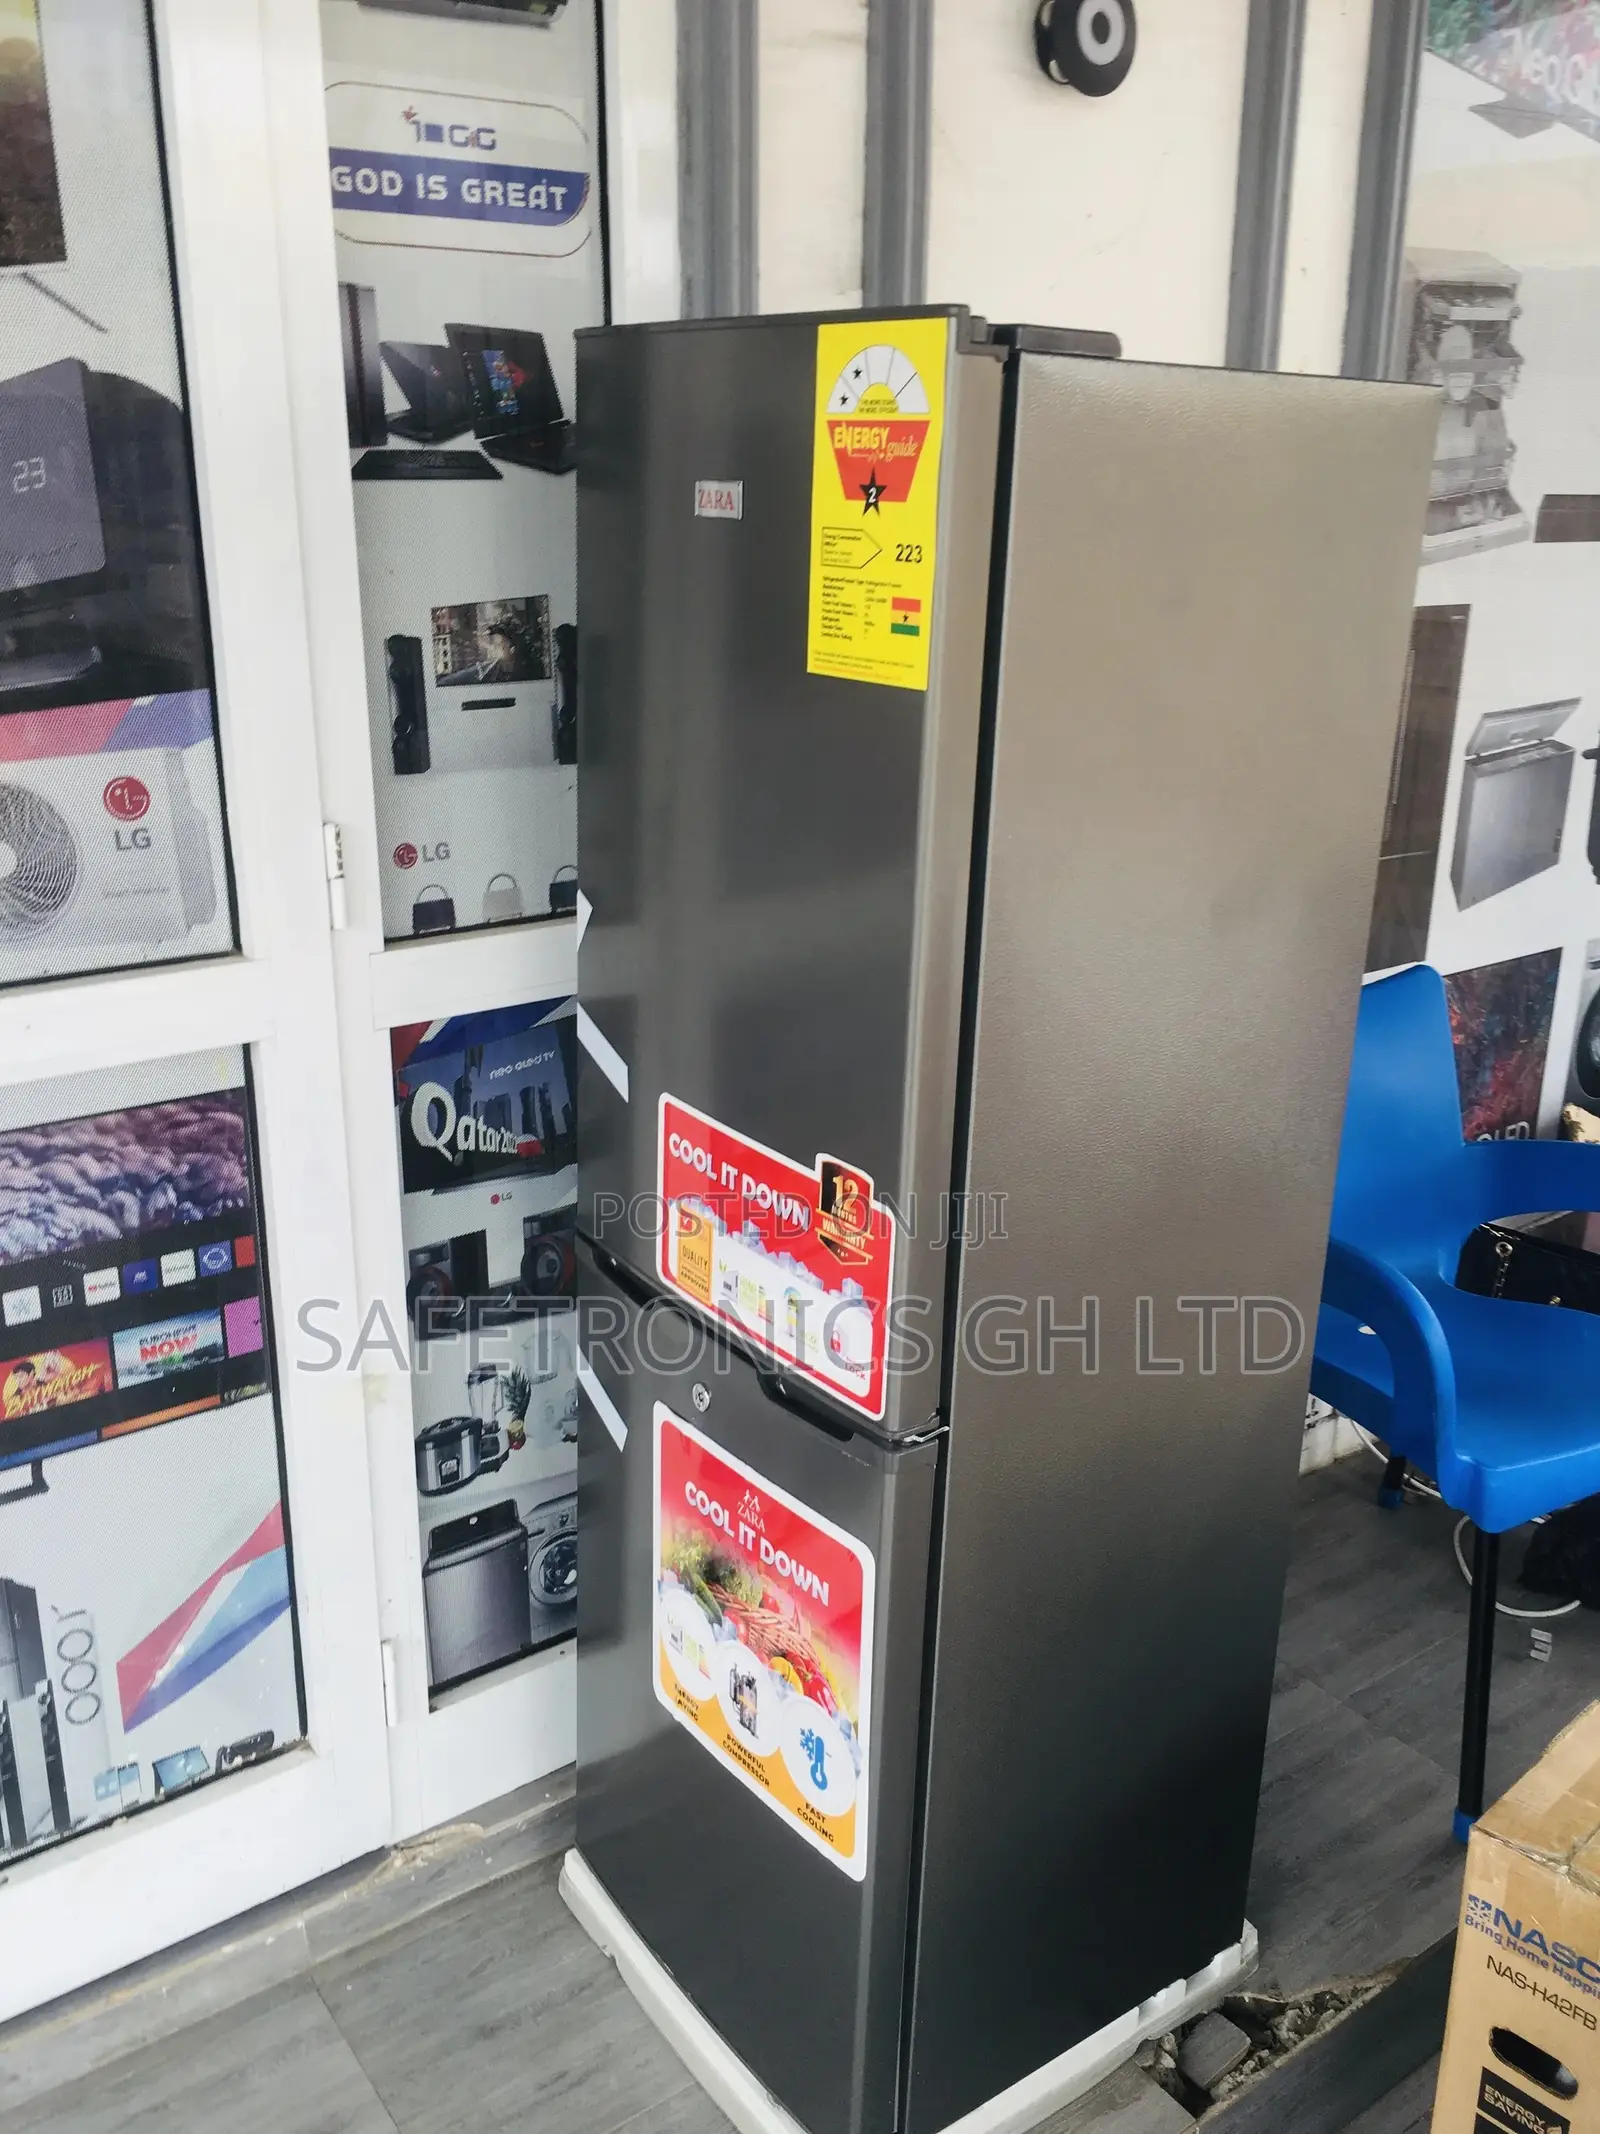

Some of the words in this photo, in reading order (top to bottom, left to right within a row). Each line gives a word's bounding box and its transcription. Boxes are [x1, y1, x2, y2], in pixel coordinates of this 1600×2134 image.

[331, 166, 404, 197] GOD
[415, 172, 449, 201] IS
[460, 178, 568, 212] GREAT
[833, 421, 891, 457] ENERGY
[12, 456, 47, 494] 23
[698, 488, 735, 511] ZARA
[868, 487, 877, 503] 2
[895, 543, 923, 564] 223
[114, 828, 152, 851] LG
[421, 841, 451, 863] LG
[669, 1132, 718, 1182] COOL
[721, 1161, 739, 1192] IT
[742, 1173, 810, 1233] DOWN
[832, 1175, 860, 1213] 12
[737, 1500, 766, 1534] ZARA
[685, 1481, 735, 1538] COOL
[738, 1520, 757, 1552] IT
[759, 1536, 829, 1607] DOWN
[721, 1741, 770, 1787] COMPRESSOR
[726, 1733, 766, 1773] POWERFUL
[796, 1806, 835, 1843] COOLING
[805, 1802, 827, 1824] FAST
[1464, 1914, 1504, 1946] Bring
[1506, 1935, 1550, 1970] Home
[1551, 1963, 1600, 2000] Happi
[1486, 1955, 1598, 2032] NAS-H42FB
[1483, 2092, 1546, 2134] SAVING
[1484, 2083, 1547, 2128] ENERGY
